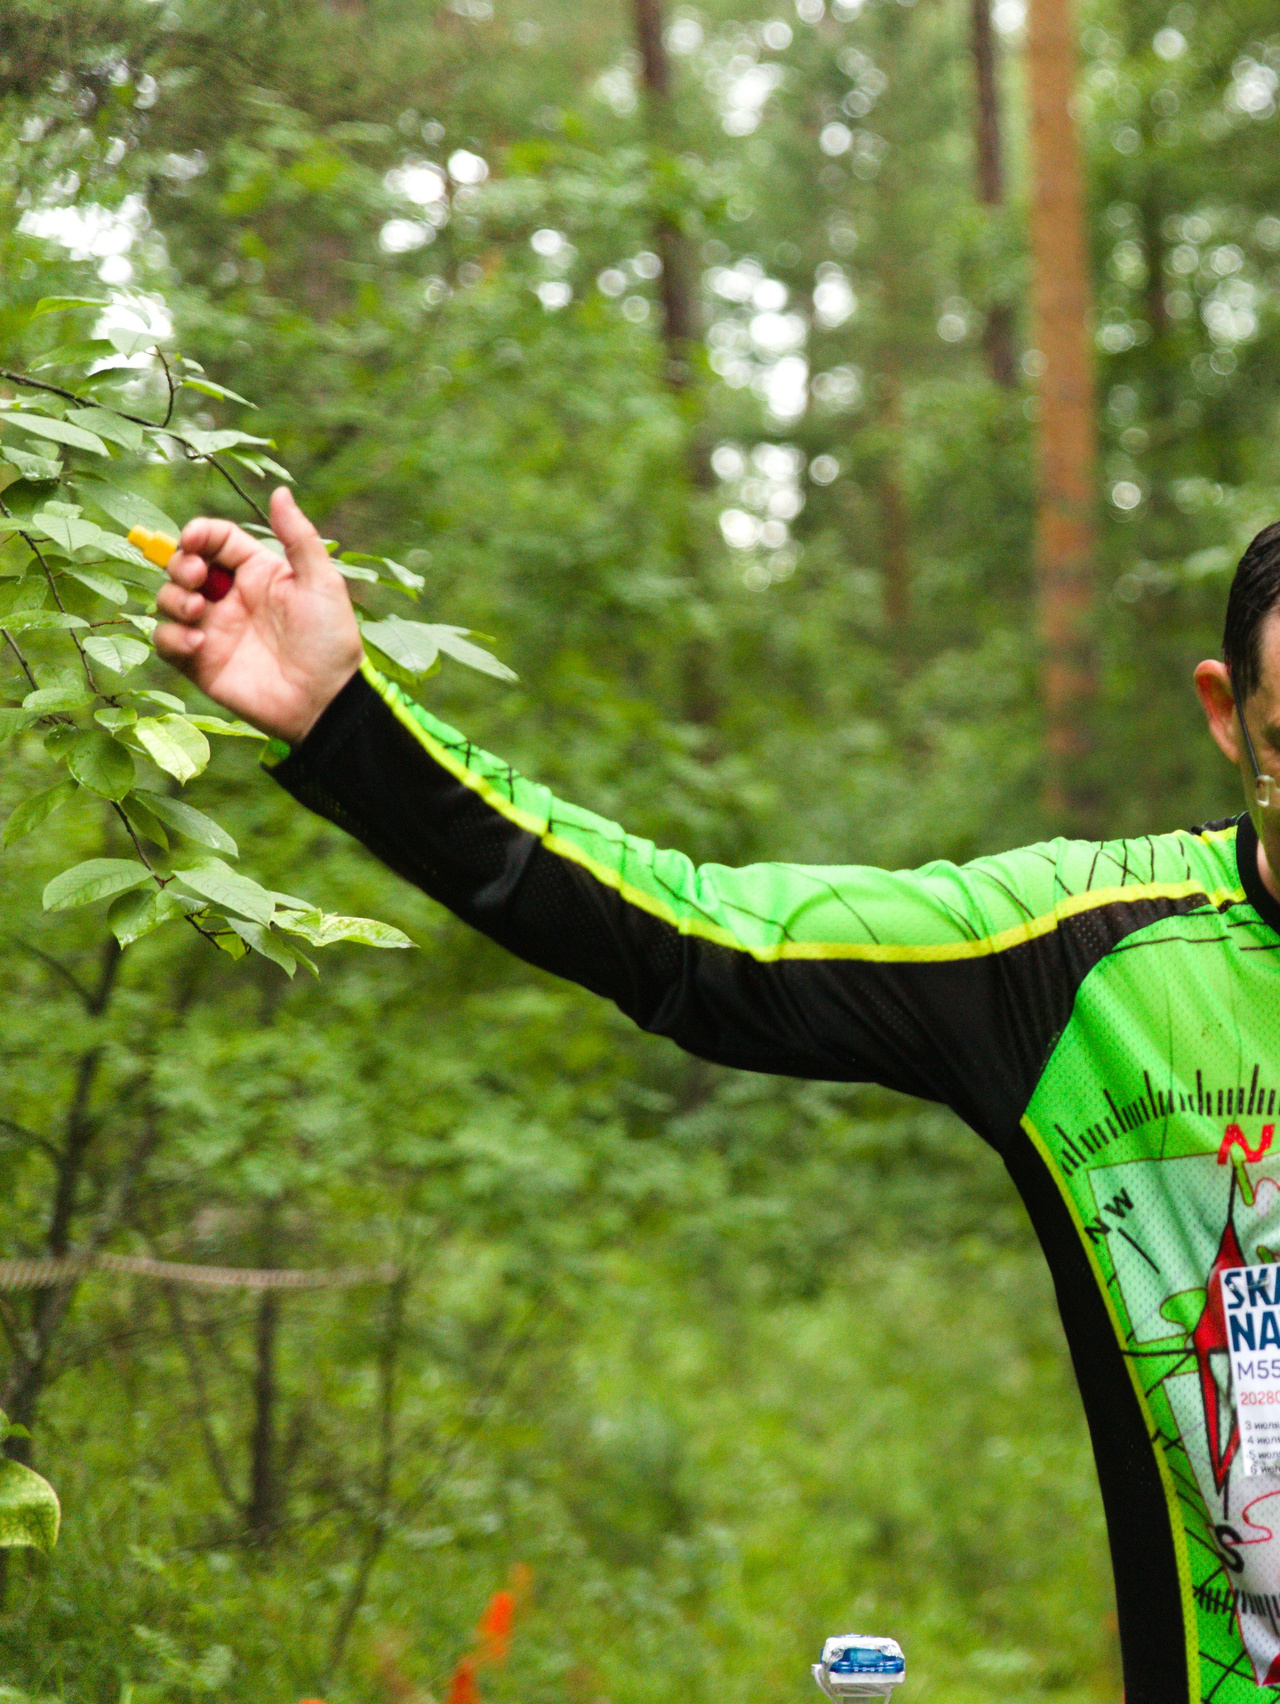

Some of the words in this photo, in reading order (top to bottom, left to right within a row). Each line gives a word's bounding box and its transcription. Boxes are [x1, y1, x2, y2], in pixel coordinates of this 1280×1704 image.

[1217, 1123, 1275, 1165] N
[1084, 1187, 1135, 1244] NW
[1245, 1419, 1252, 1430] 3
[1254, 1422, 1280, 1430] июля
[1247, 1436, 1254, 1444] 4
[1249, 1449, 1256, 1460] 5
[1250, 1465, 1258, 1475] 6
[1214, 1524, 1245, 1574] S
